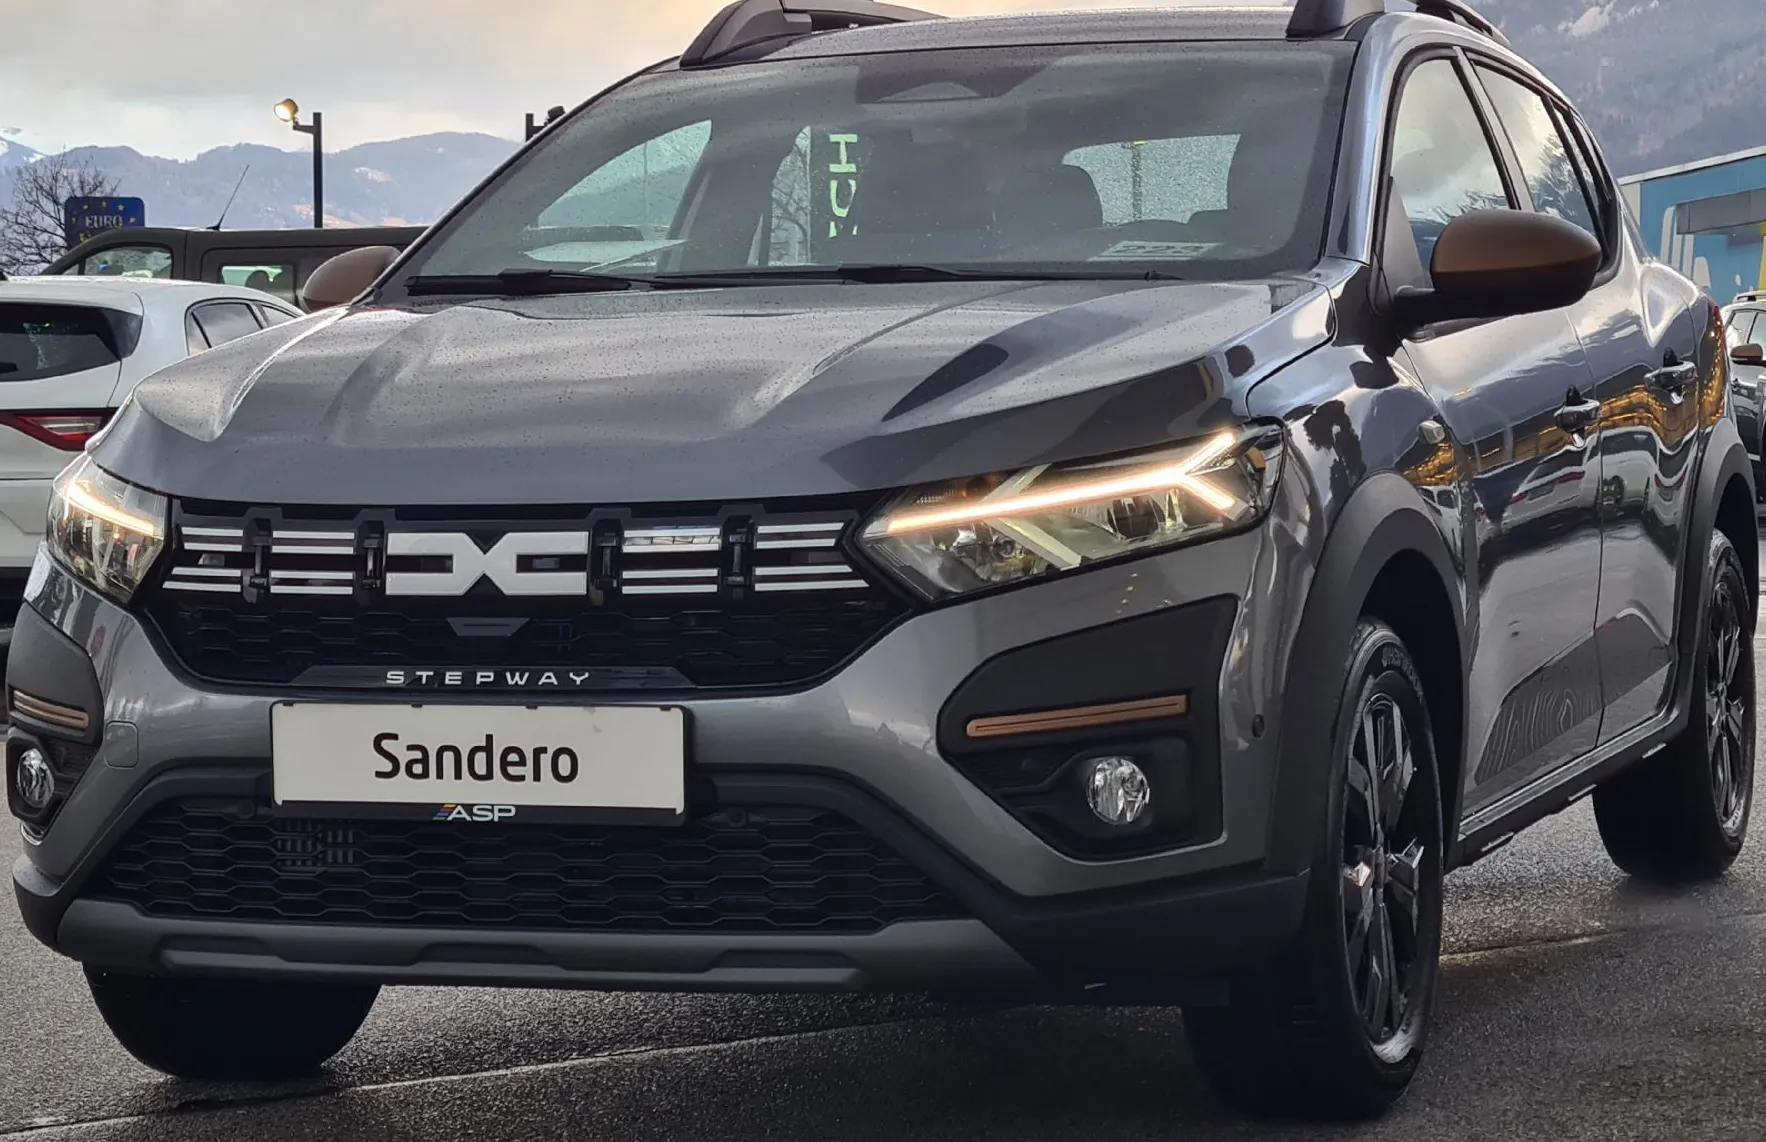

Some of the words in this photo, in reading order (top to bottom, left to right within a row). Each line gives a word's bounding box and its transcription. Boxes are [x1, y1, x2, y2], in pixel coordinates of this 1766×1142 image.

[84, 214, 123, 229] EURO
[386, 671, 589, 686] STEPWAY
[373, 732, 579, 784] Sandero
[446, 804, 516, 822] ASP
